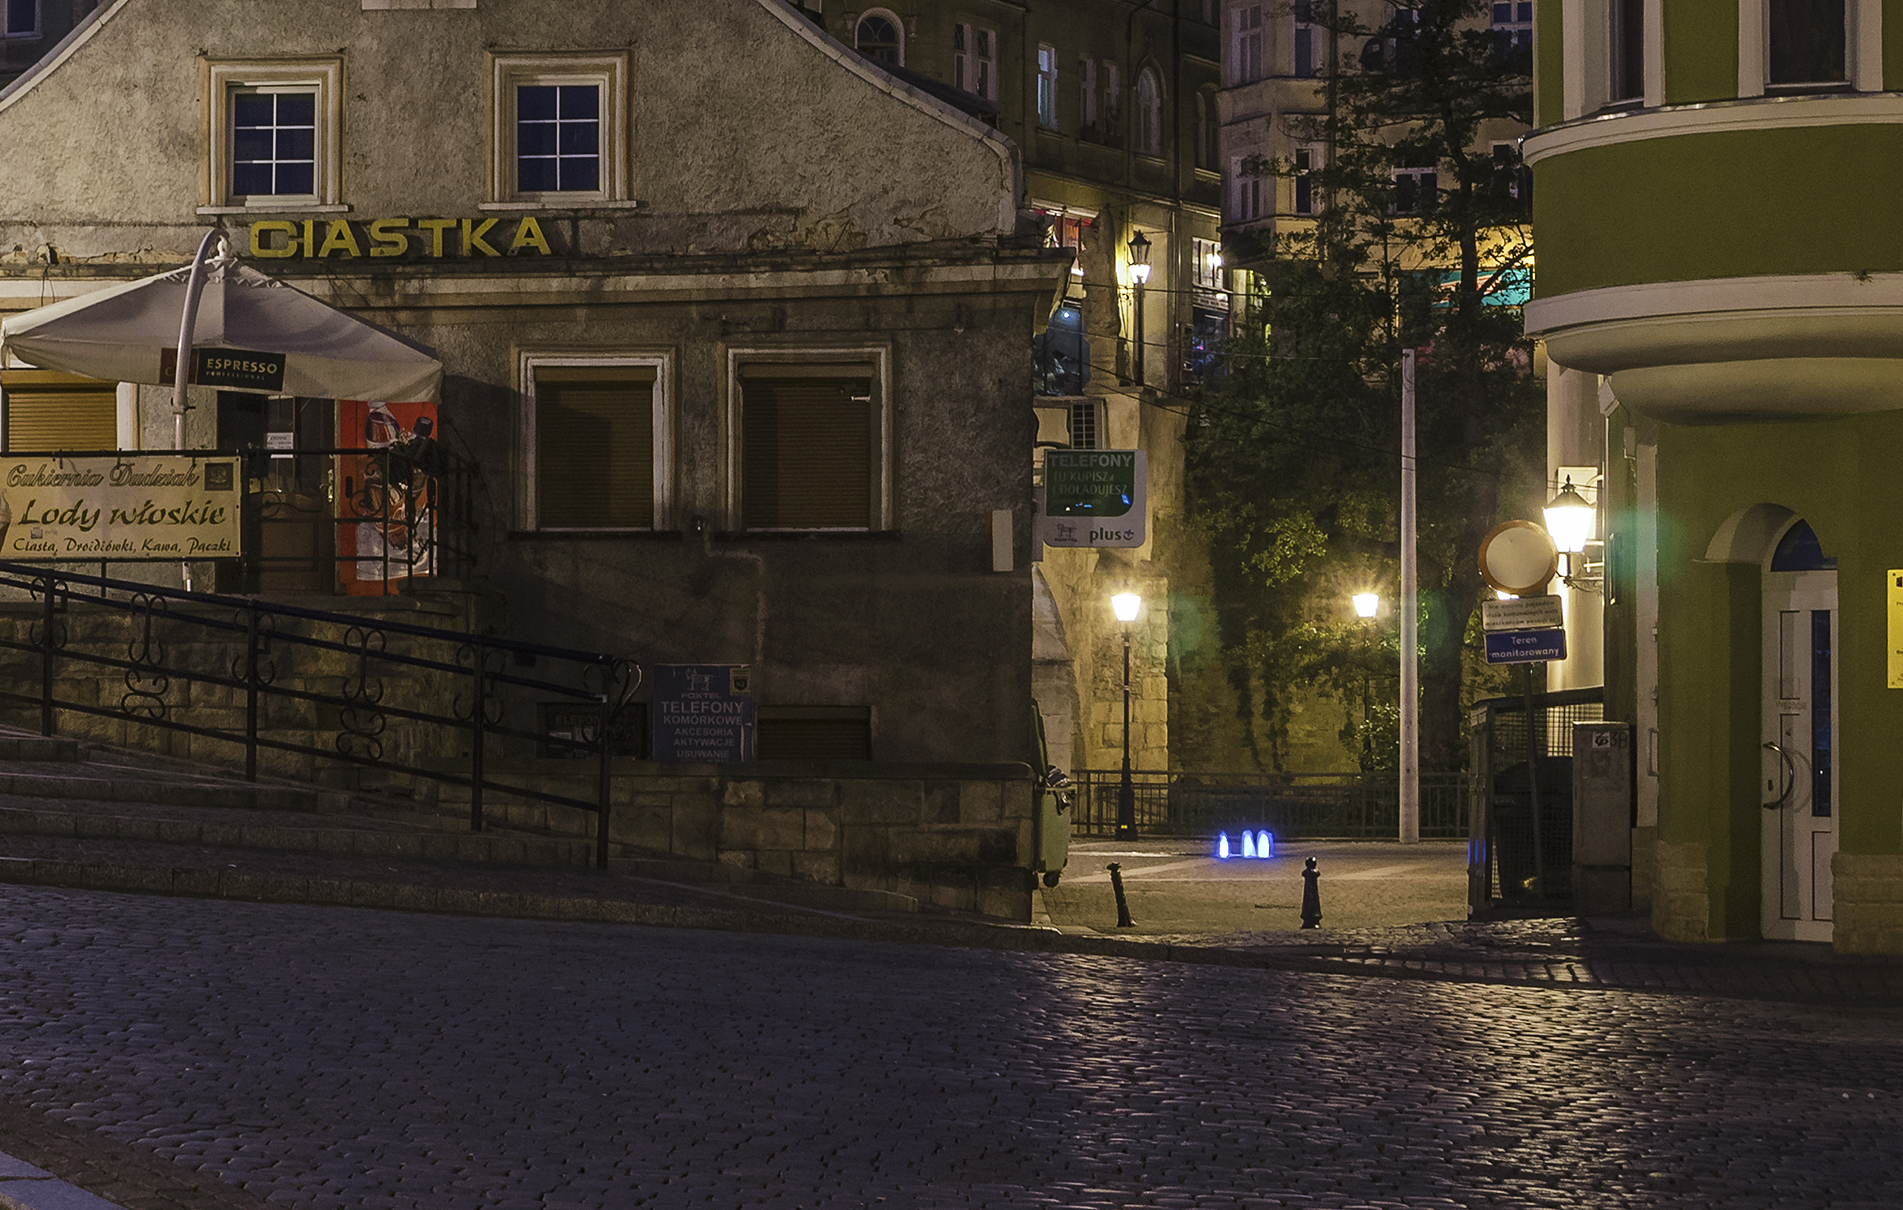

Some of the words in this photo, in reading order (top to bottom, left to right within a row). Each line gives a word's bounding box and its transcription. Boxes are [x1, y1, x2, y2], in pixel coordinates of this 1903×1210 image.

[249, 216, 552, 258] CIASTKA
[207, 358, 278, 374] ESPRESSO
[1049, 454, 1132, 467] TELEFONY
[6, 464, 104, 487] Cukiernia
[109, 463, 199, 487] Dudziak
[1070, 471, 1109, 482] KUPISZ
[18, 498, 101, 532] Lody
[109, 499, 227, 525] włoskie
[1089, 527, 1122, 544] plus
[1510, 636, 1537, 645] Teren
[1491, 648, 1560, 658] monitorowany
[661, 701, 744, 714] TELEFONY
[674, 727, 734, 736] AKCESORIA
[673, 738, 735, 747] AKTYWACJE
[677, 750, 730, 759] USUWANIE
